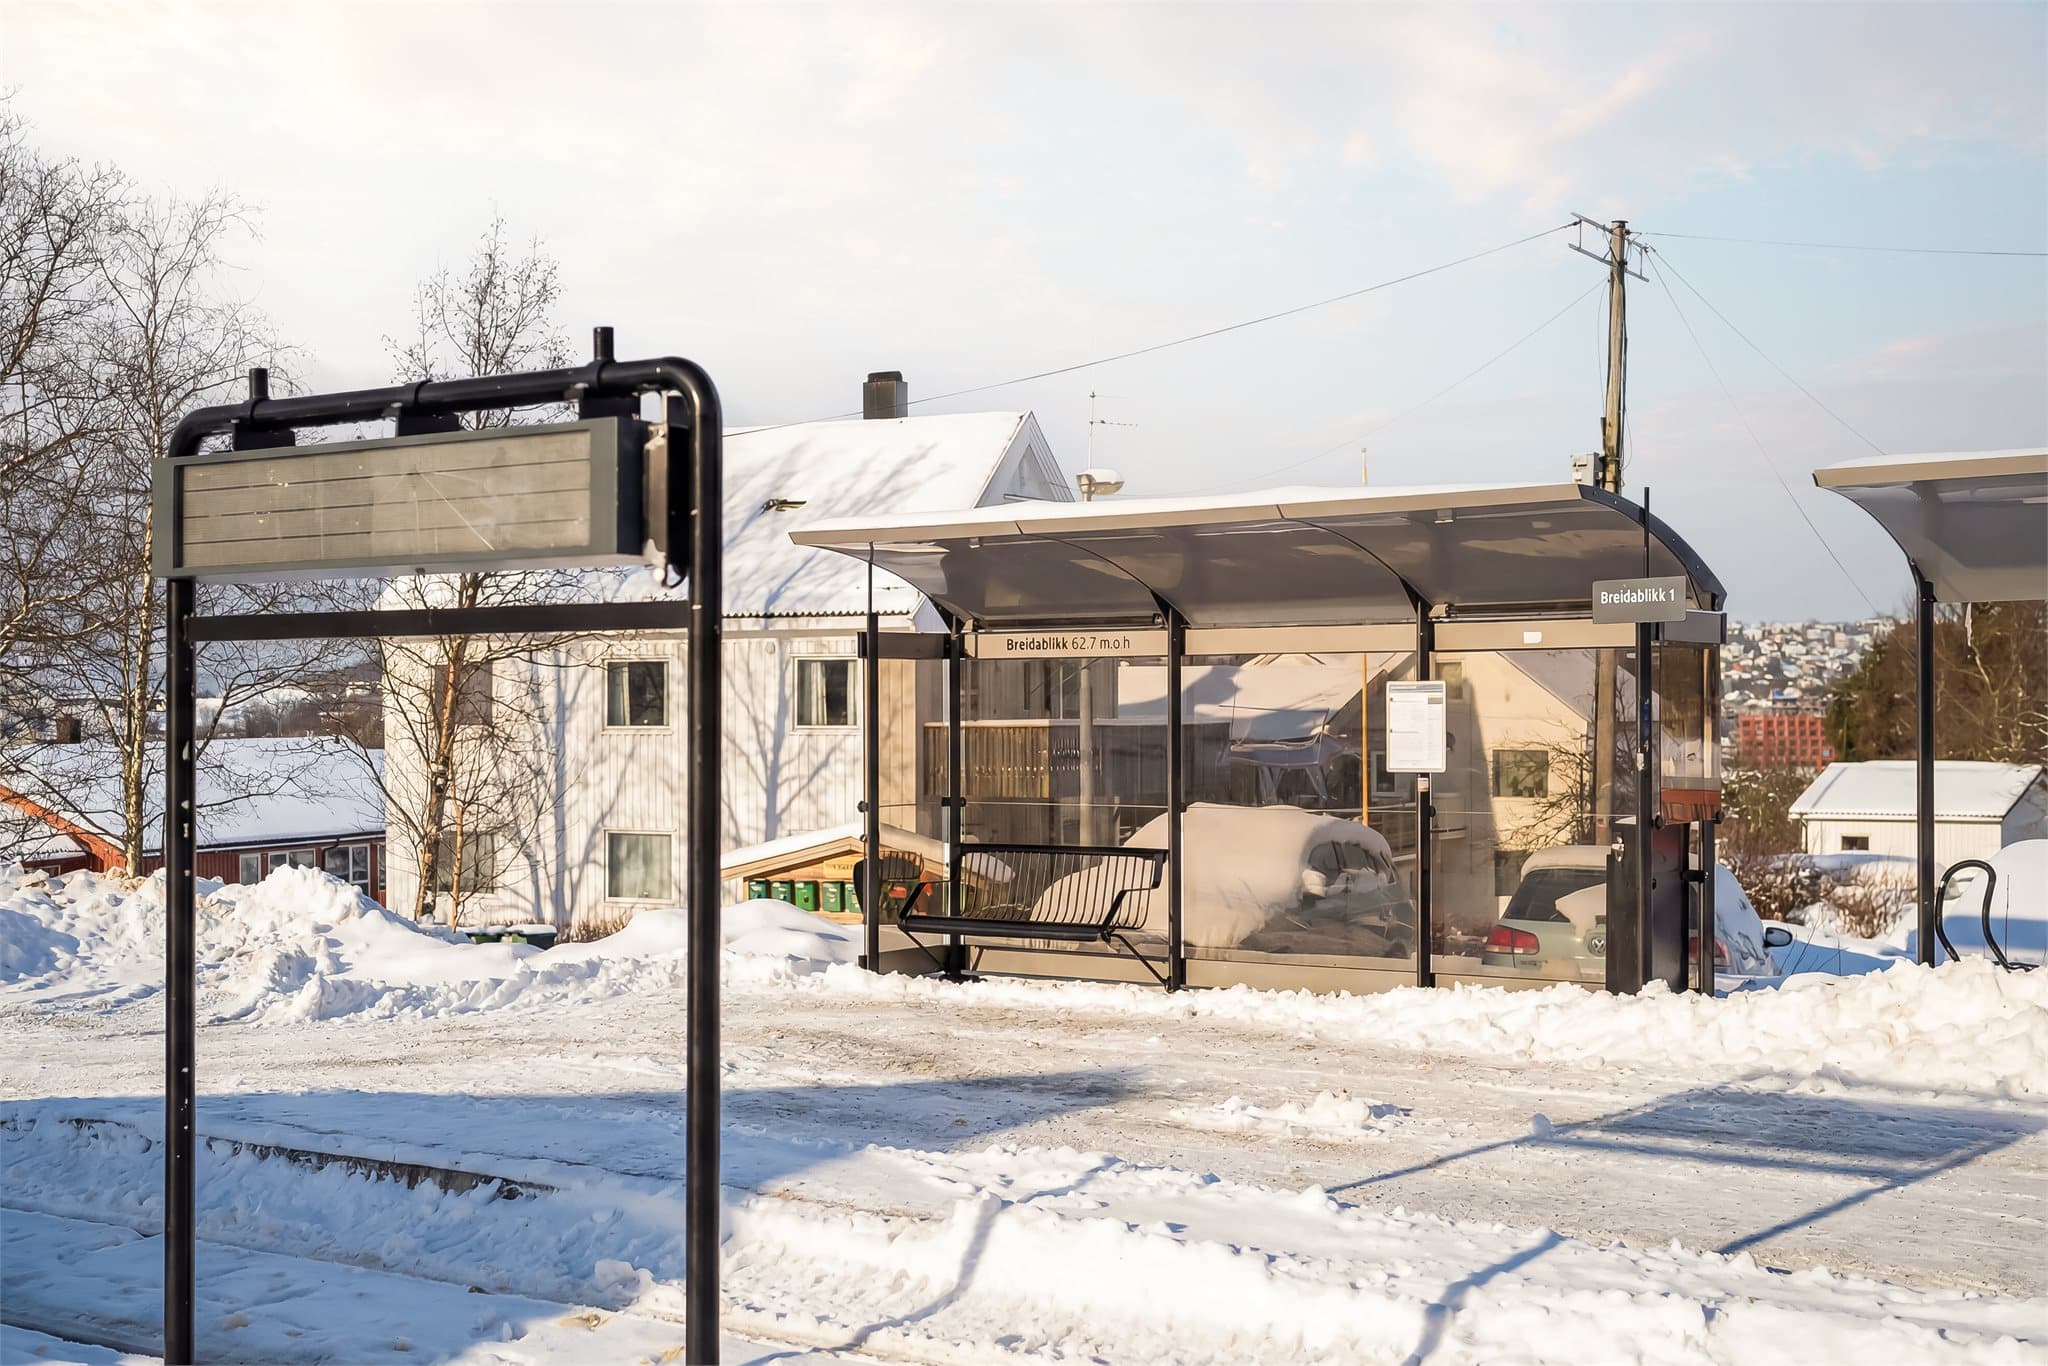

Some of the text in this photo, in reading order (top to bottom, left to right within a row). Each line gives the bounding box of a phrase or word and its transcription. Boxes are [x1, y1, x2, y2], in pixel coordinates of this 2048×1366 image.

[1601, 588, 1675, 604] Breidablikk 1
[1007, 637, 1068, 651] Breidablikk
[1072, 637, 1096, 650] 62.7
